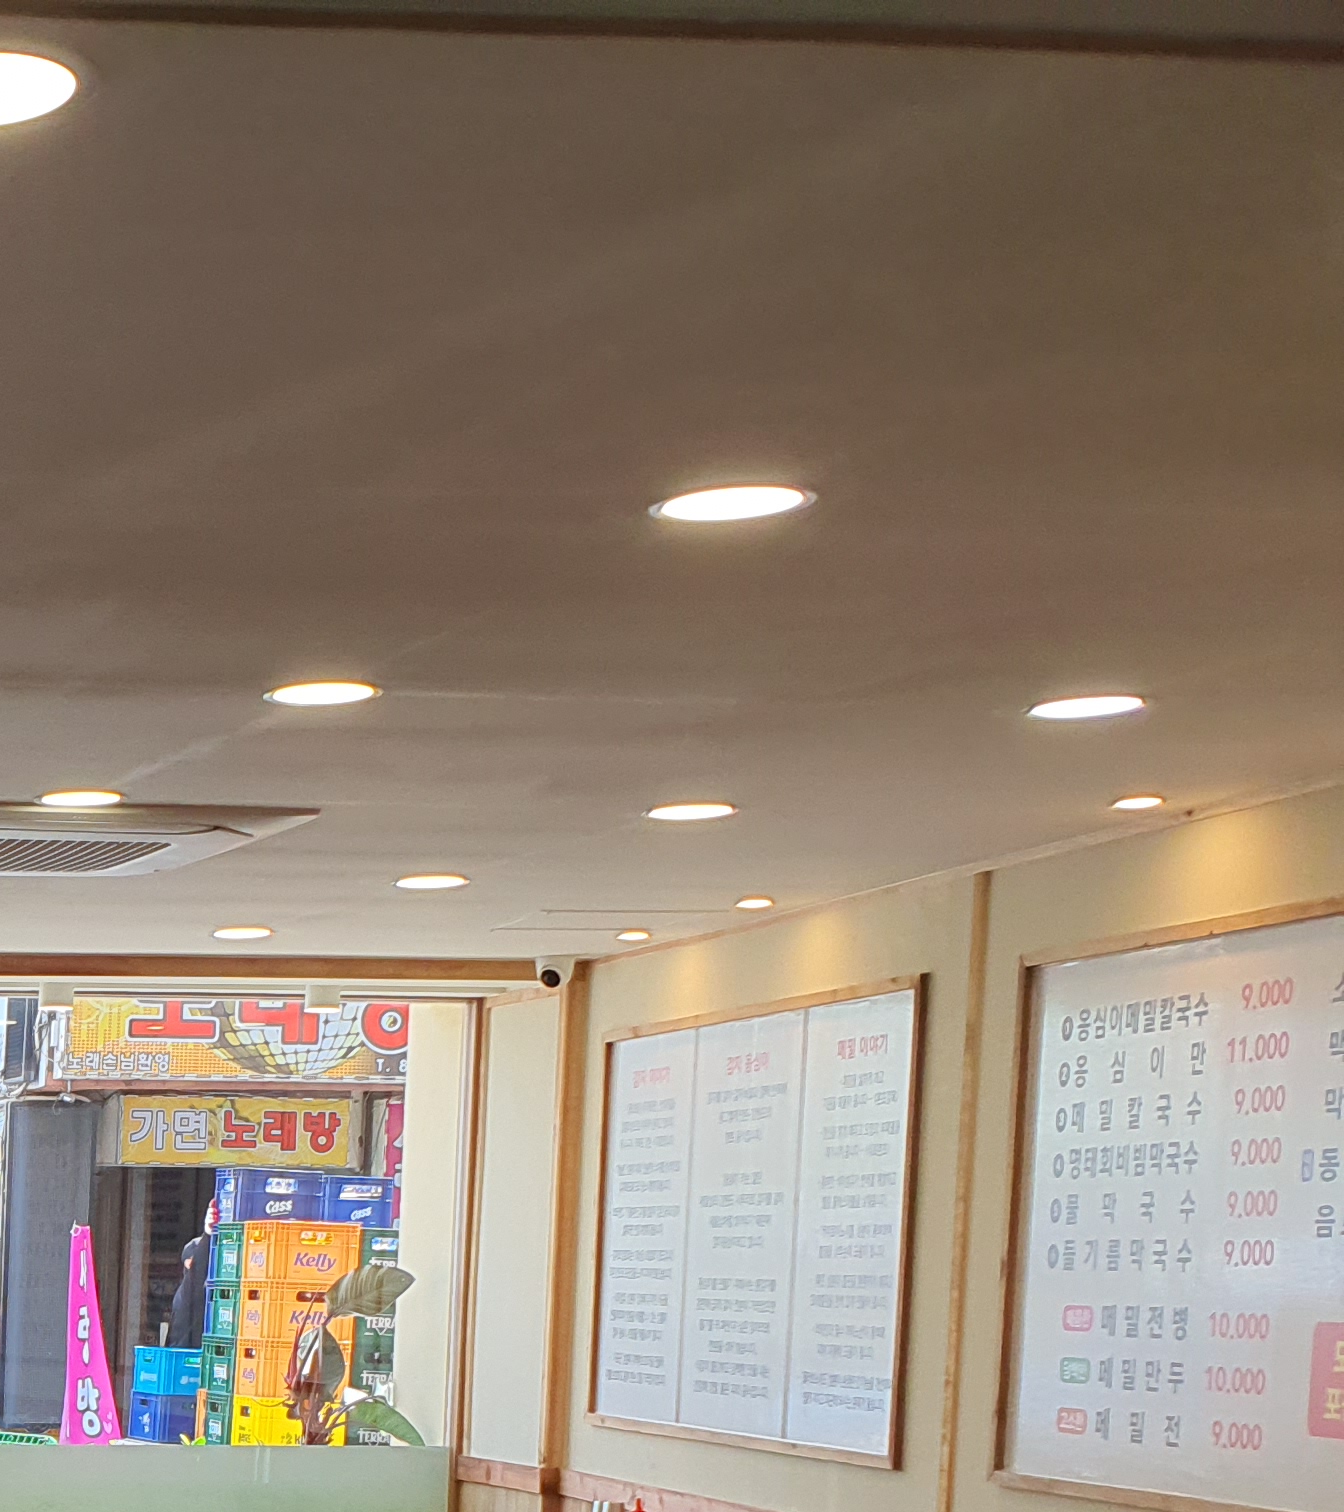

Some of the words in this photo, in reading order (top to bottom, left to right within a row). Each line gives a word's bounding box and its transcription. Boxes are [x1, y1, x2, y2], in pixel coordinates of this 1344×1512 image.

[1241, 977, 1294, 1010] 9.000
[1227, 1031, 1290, 1064] 11.000
[1234, 1085, 1286, 1115] 9.000
[129, 1109, 209, 1151] 가면
[220, 1109, 342, 1154] 노래방
[1231, 1136, 1282, 1166] 9.000
[1227, 1189, 1278, 1219] 9.000
[293, 1252, 337, 1273] Kelly
[1223, 1239, 1275, 1267] 9.000
[1209, 1311, 1270, 1340] 10.000
[1205, 1365, 1266, 1395] 10.000
[1212, 1419, 1263, 1450] 9.000
